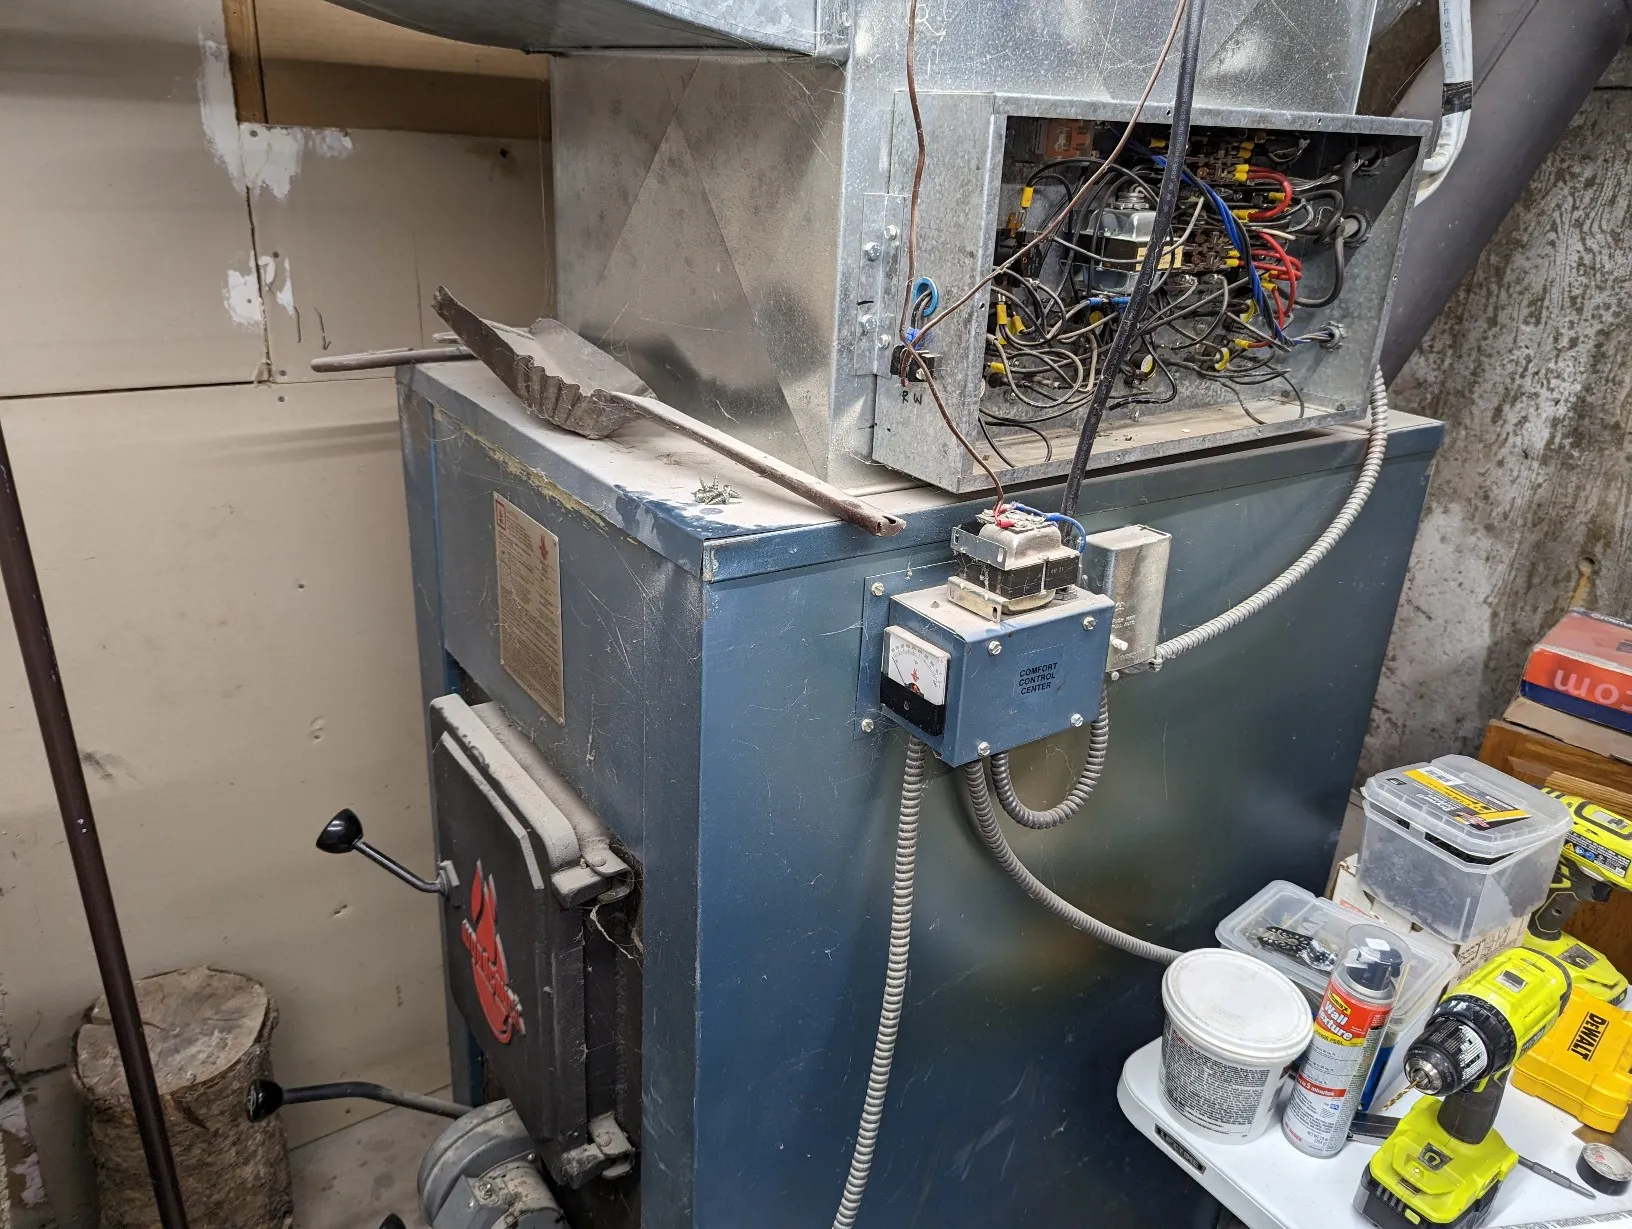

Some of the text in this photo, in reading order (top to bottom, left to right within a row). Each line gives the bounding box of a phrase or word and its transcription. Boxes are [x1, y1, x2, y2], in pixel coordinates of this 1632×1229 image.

[901, 390, 923, 405] R W
[1019, 662, 1058, 677] COMFORT
[1018, 672, 1056, 687] CONTROL
[1020, 681, 1052, 695] CENTER
[1325, 1001, 1349, 1026] Wall
